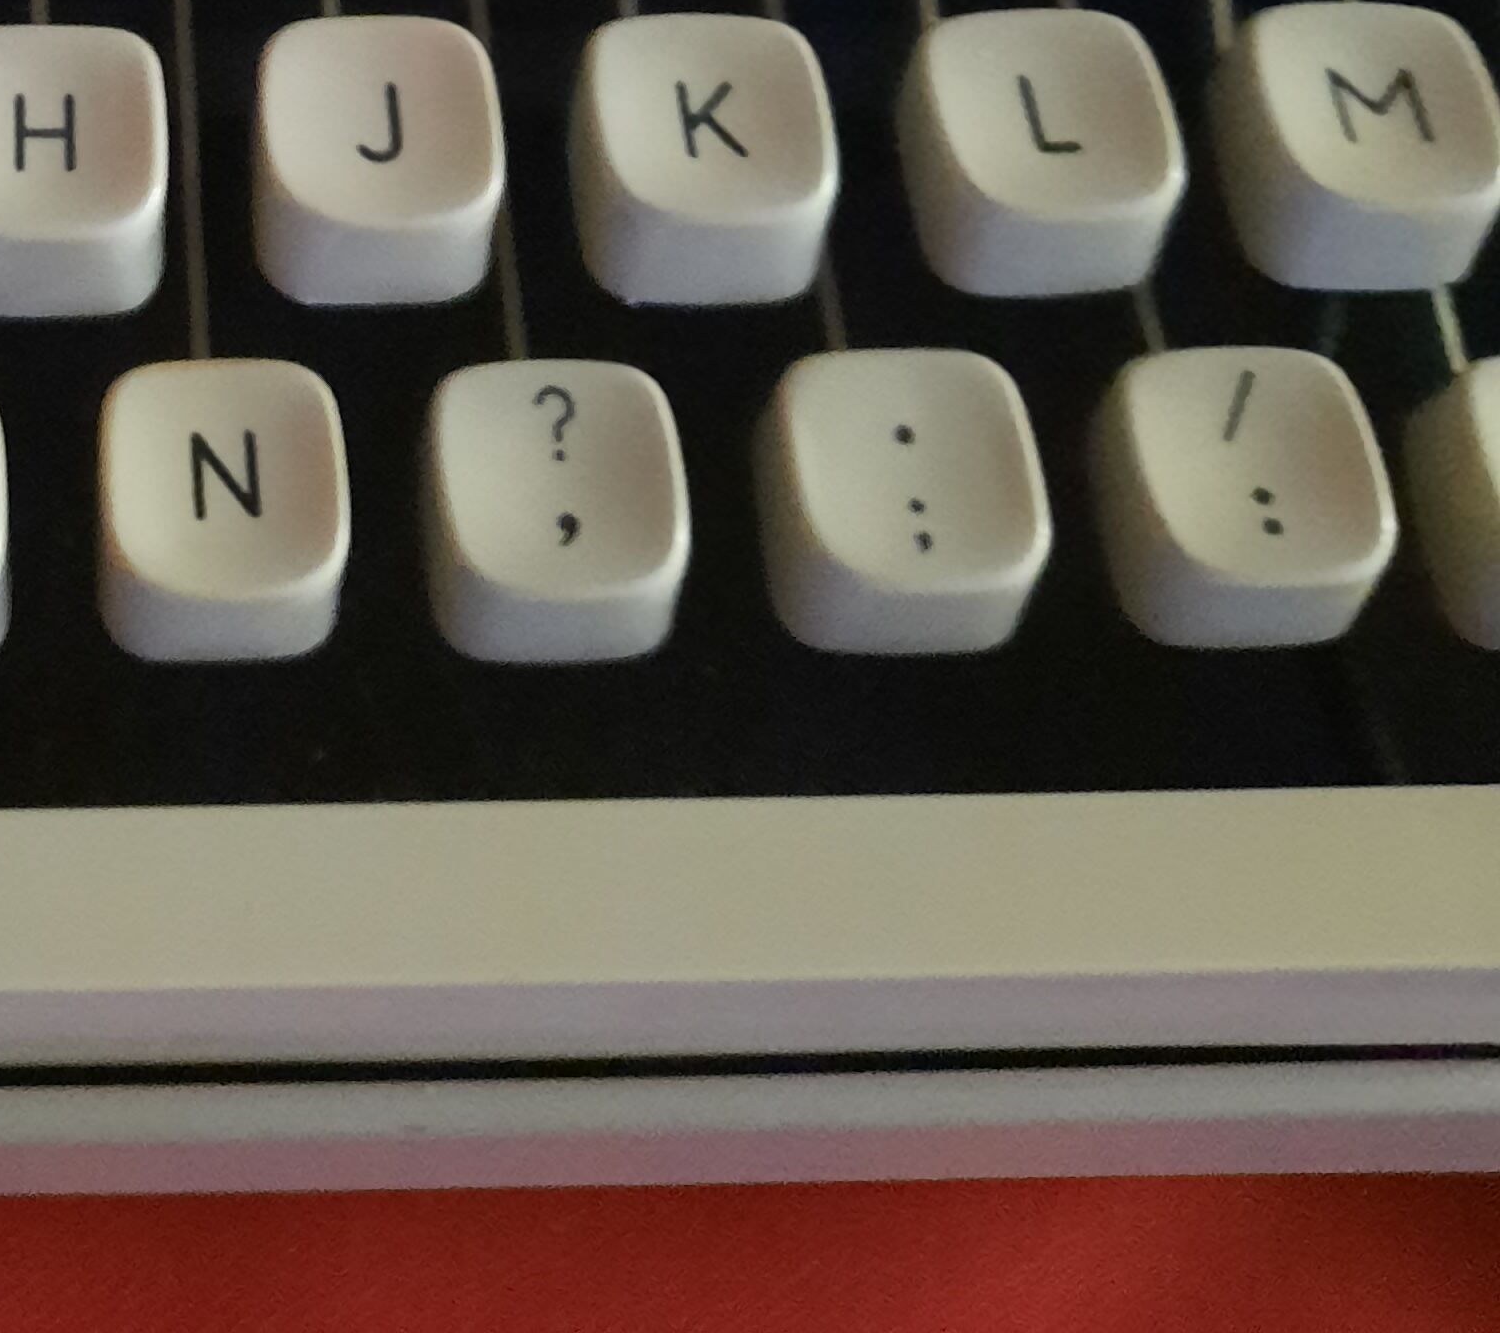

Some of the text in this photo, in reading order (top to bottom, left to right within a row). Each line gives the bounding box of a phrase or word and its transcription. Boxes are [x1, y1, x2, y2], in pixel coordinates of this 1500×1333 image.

[13, 93, 78, 172] H
[355, 82, 405, 164] J
[674, 80, 749, 159] K
[1018, 74, 1083, 153] L
[1326, 67, 1435, 143] M
[531, 385, 576, 462] ?
[1221, 369, 1257, 442] /
[190, 430, 262, 520] N
[1250, 486, 1284, 536] :
[557, 512, 581, 546] ,
